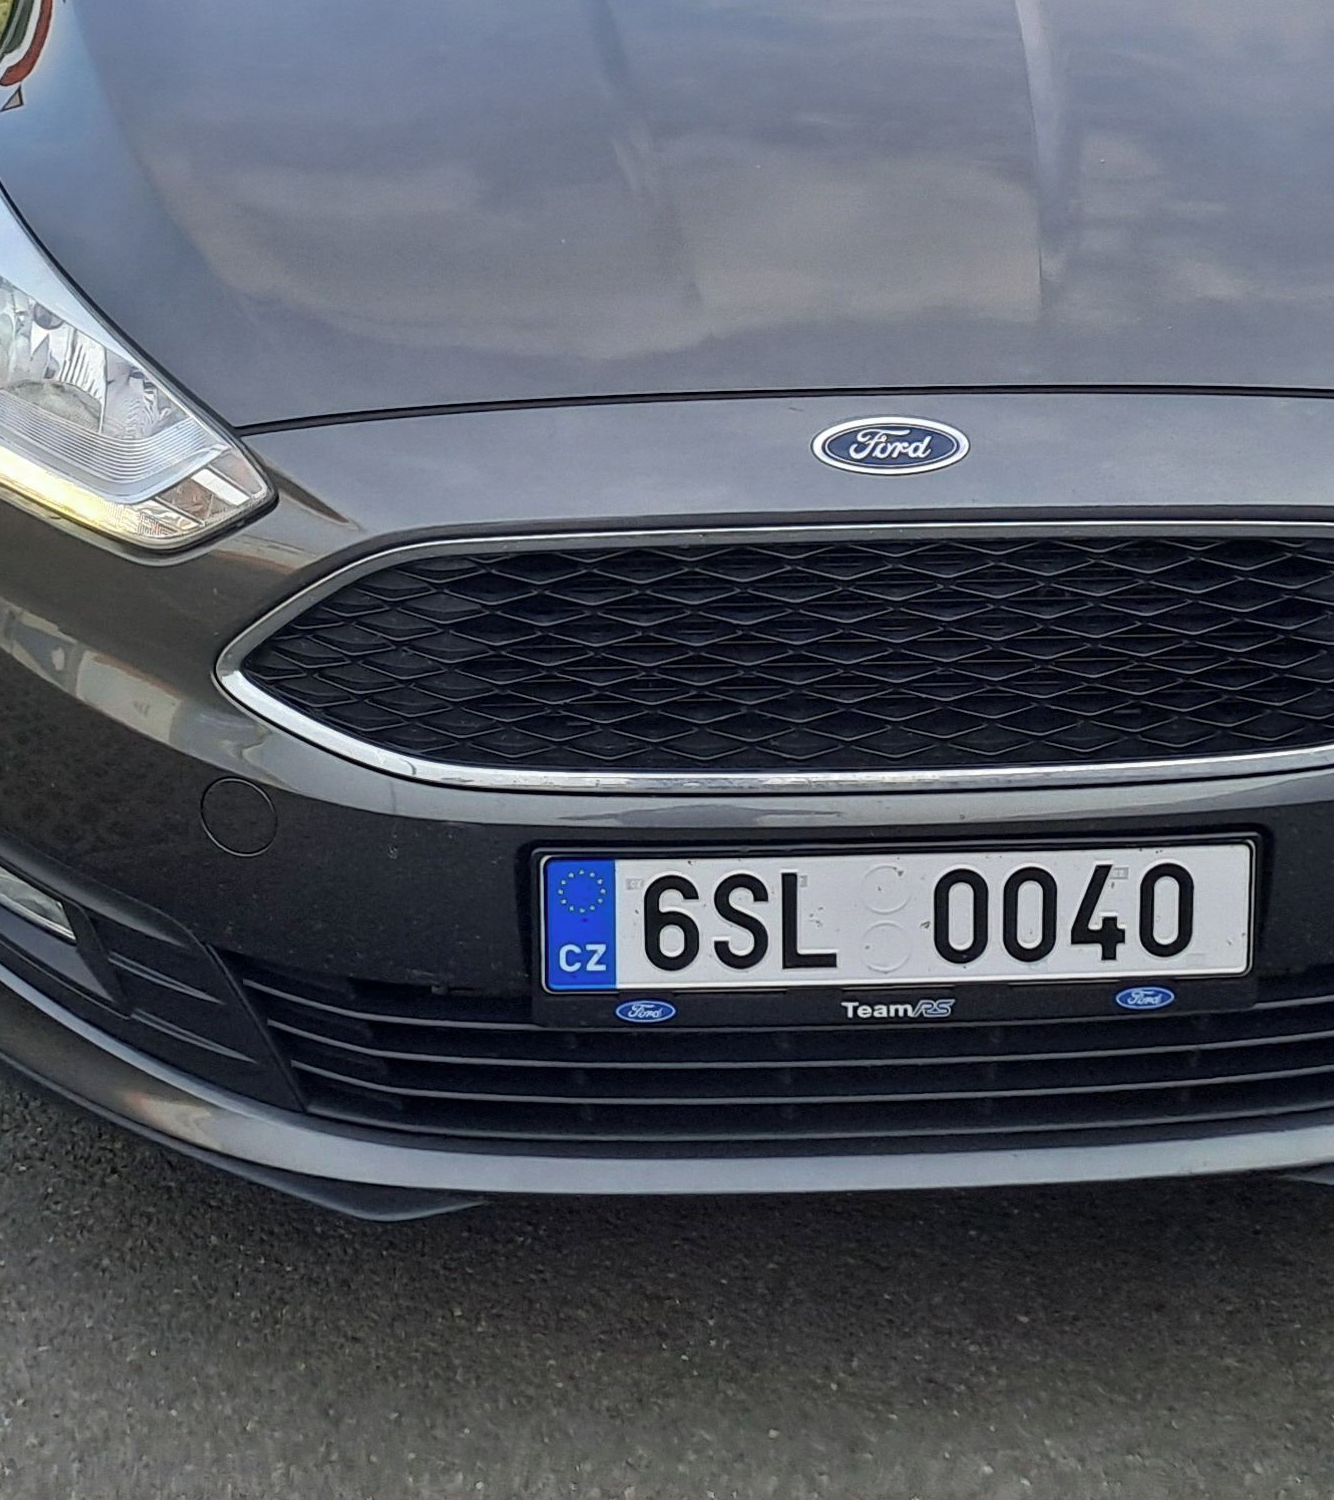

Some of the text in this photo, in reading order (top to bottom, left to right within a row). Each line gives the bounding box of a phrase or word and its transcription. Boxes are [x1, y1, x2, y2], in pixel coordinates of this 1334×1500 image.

[849, 429, 933, 460] Ford
[558, 863, 1194, 973] CZ 6SL 0040
[1127, 989, 1163, 1006] Ford
[627, 1003, 664, 1019] Ford
